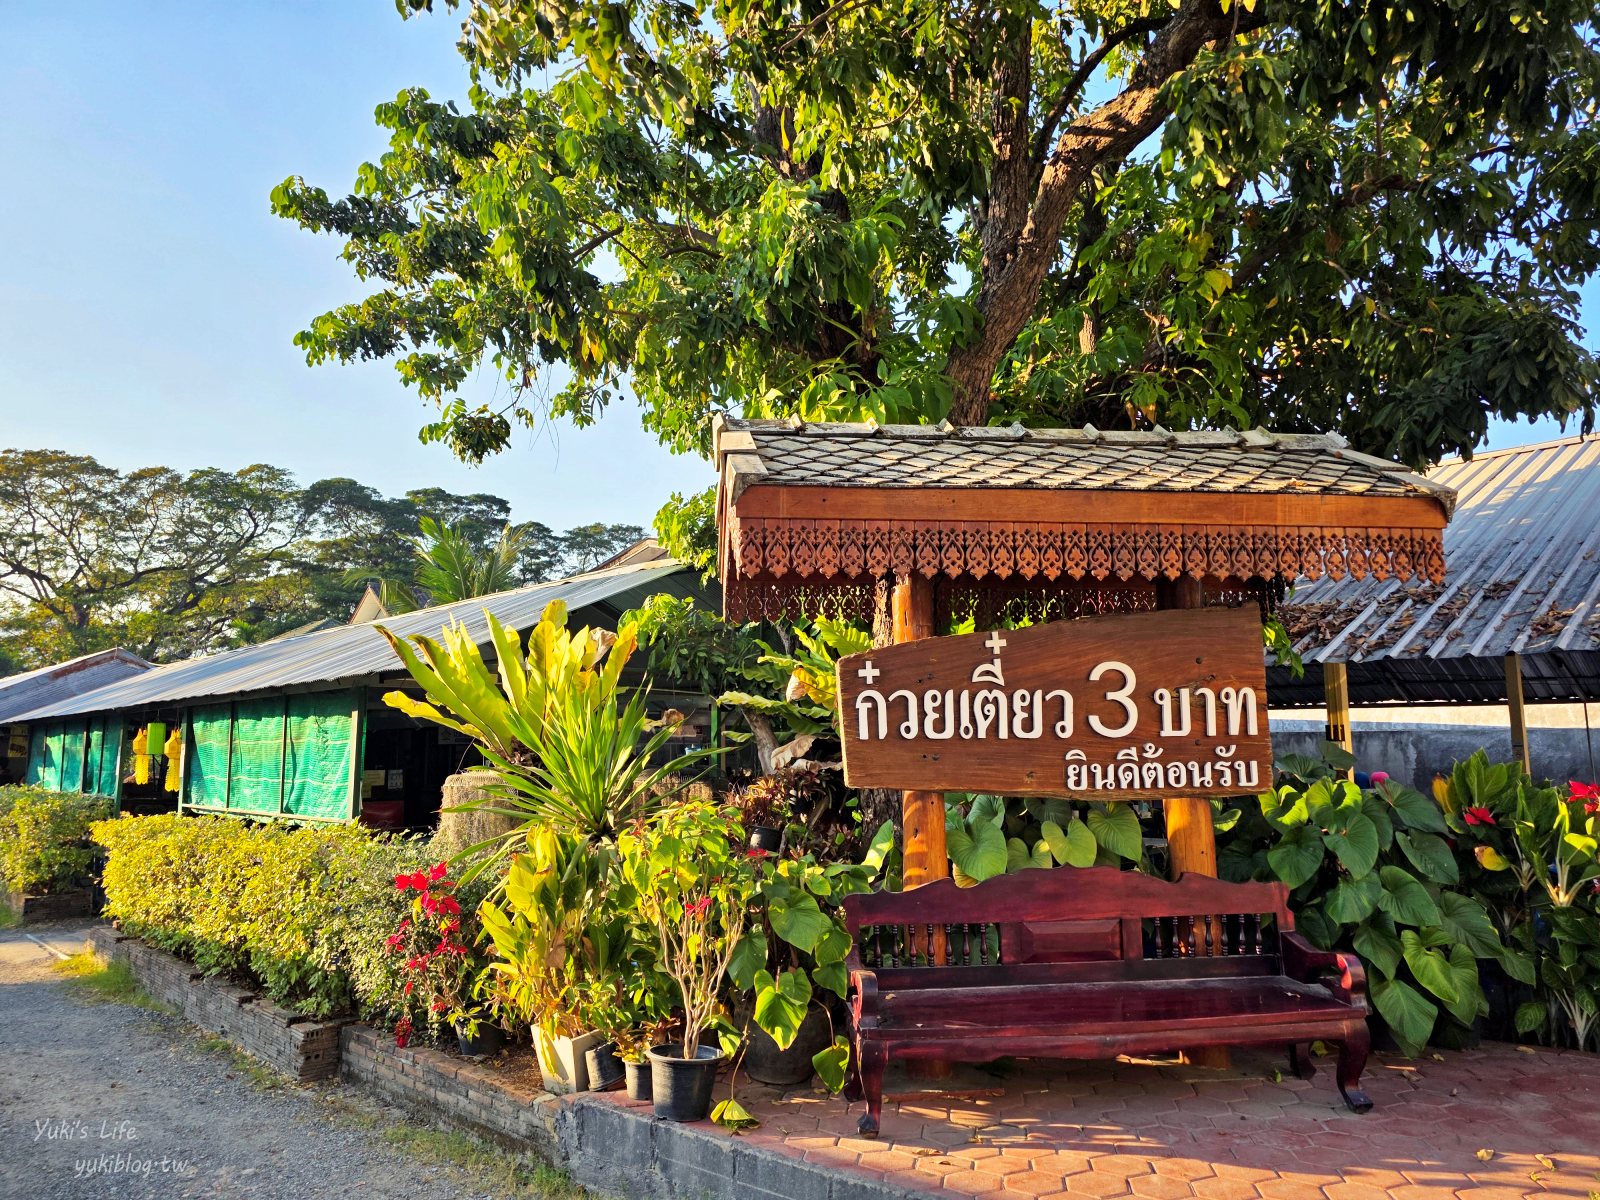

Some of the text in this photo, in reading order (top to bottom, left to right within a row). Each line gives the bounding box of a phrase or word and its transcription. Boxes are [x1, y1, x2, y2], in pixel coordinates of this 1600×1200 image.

[855, 631, 1259, 740] ก๋วยเตี๋ยว 3 บาท
[1065, 742, 1259, 791] ยินดีต้อนรับ
